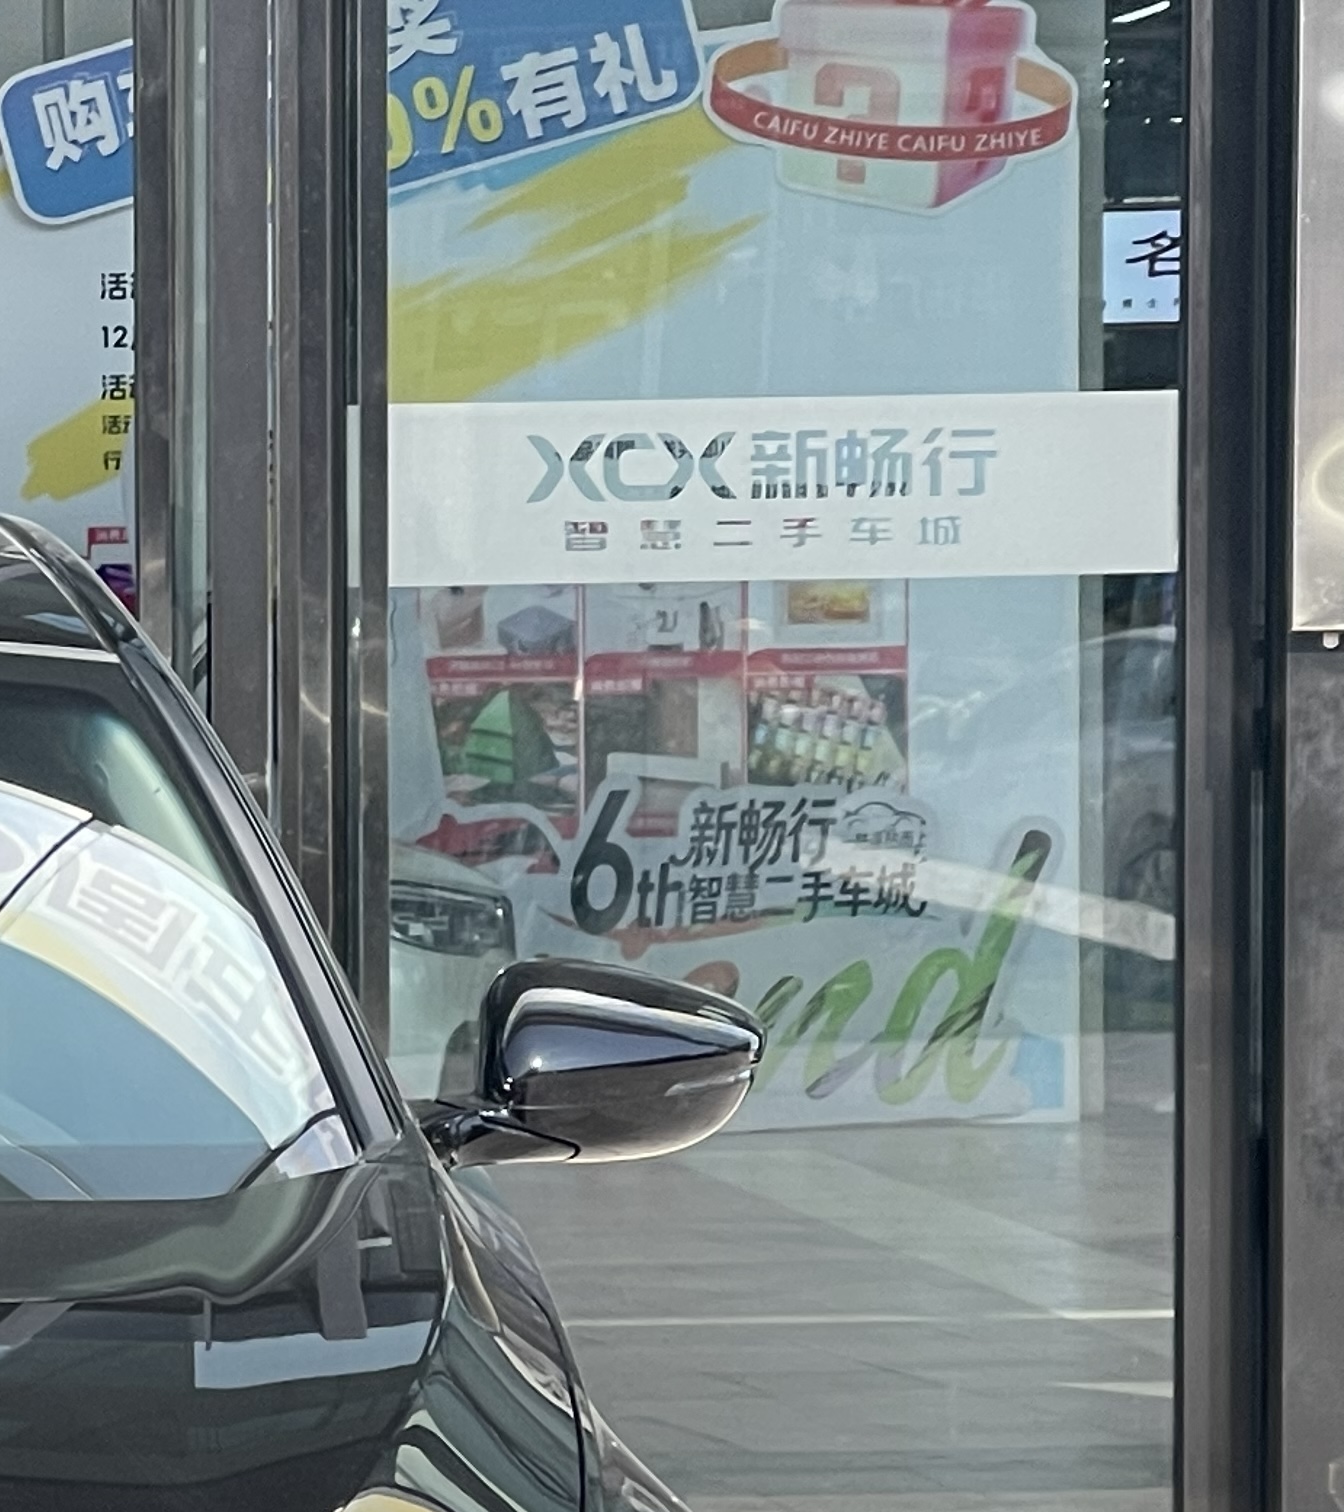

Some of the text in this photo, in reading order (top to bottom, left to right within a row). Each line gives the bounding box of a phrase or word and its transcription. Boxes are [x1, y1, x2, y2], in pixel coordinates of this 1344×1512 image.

[32, 72, 134, 171] 购
[753, 111, 1043, 152] CAIFU ZHIYE CAIFU ZHIYE
[100, 272, 134, 300] 活
[101, 325, 135, 350] 12
[101, 374, 134, 400] 活
[750, 427, 998, 499] 新畅行
[564, 516, 962, 552] 智慧二手车城
[669, 797, 838, 870] 新畅行
[688, 862, 928, 923] 智慧二手车城
